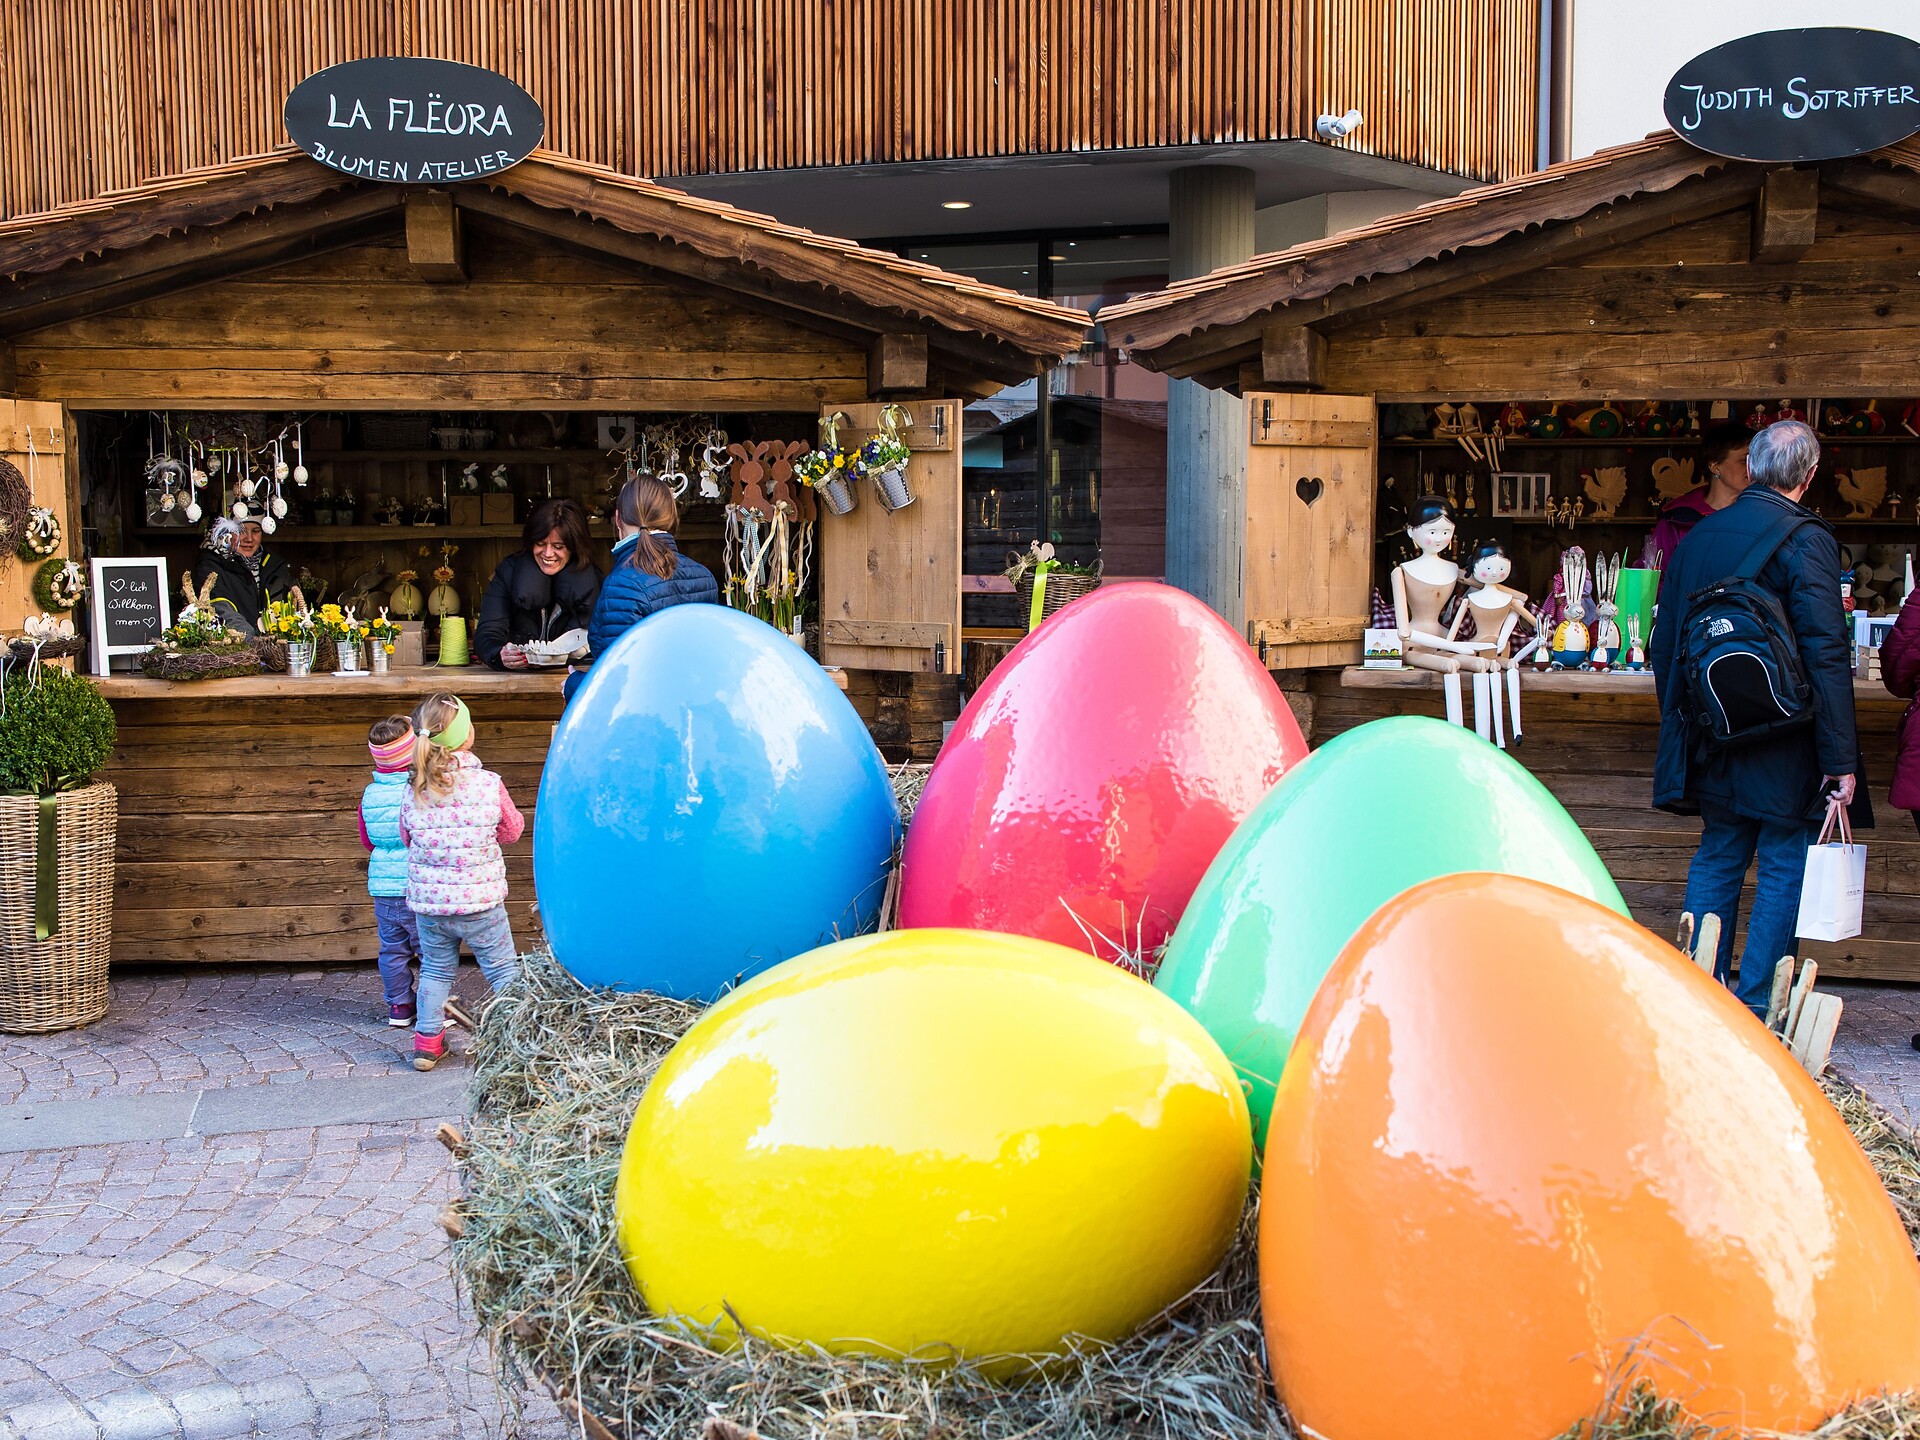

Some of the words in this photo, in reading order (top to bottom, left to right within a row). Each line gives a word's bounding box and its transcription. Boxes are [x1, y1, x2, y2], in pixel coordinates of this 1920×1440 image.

[328, 94, 371, 130] LA
[388, 92, 513, 137] FLËURA
[1680, 84, 1773, 130] JUDITH
[1782, 76, 1920, 119] SOTRIFFER
[311, 141, 408, 181] BLUMEN
[418, 150, 515, 180] ATELIER
[1710, 619, 1721, 628] THE
[1711, 627, 1725, 638] FACE
